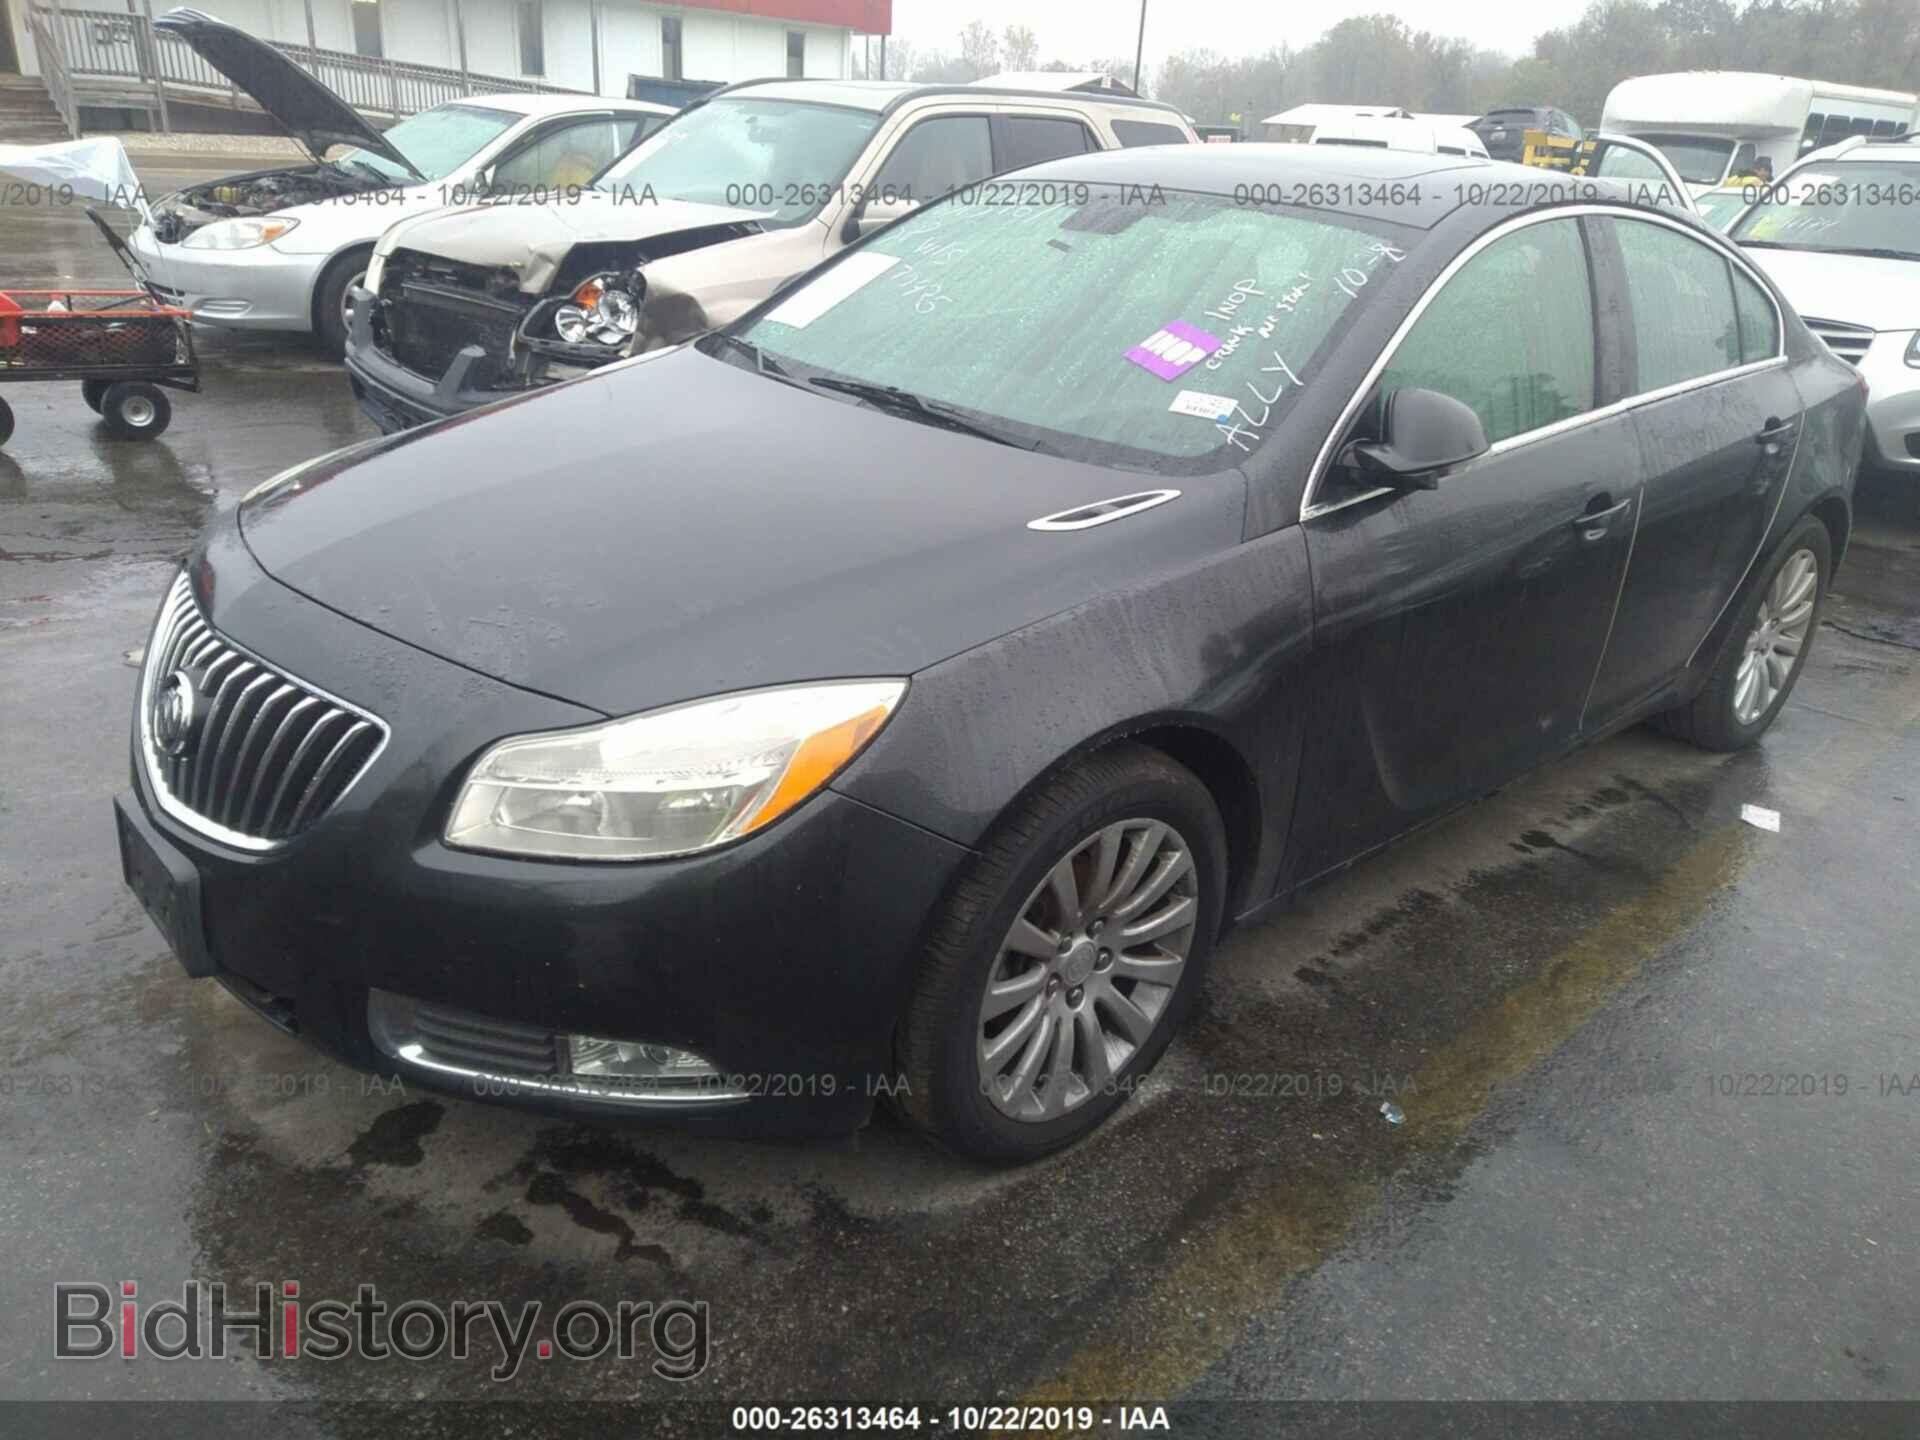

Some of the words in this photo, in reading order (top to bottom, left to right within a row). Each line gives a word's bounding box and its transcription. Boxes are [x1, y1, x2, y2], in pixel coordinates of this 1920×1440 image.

[1203, 279, 1264, 321] INOP
[1139, 329, 1207, 367] INOP
[1215, 351, 1305, 452] ALLY
